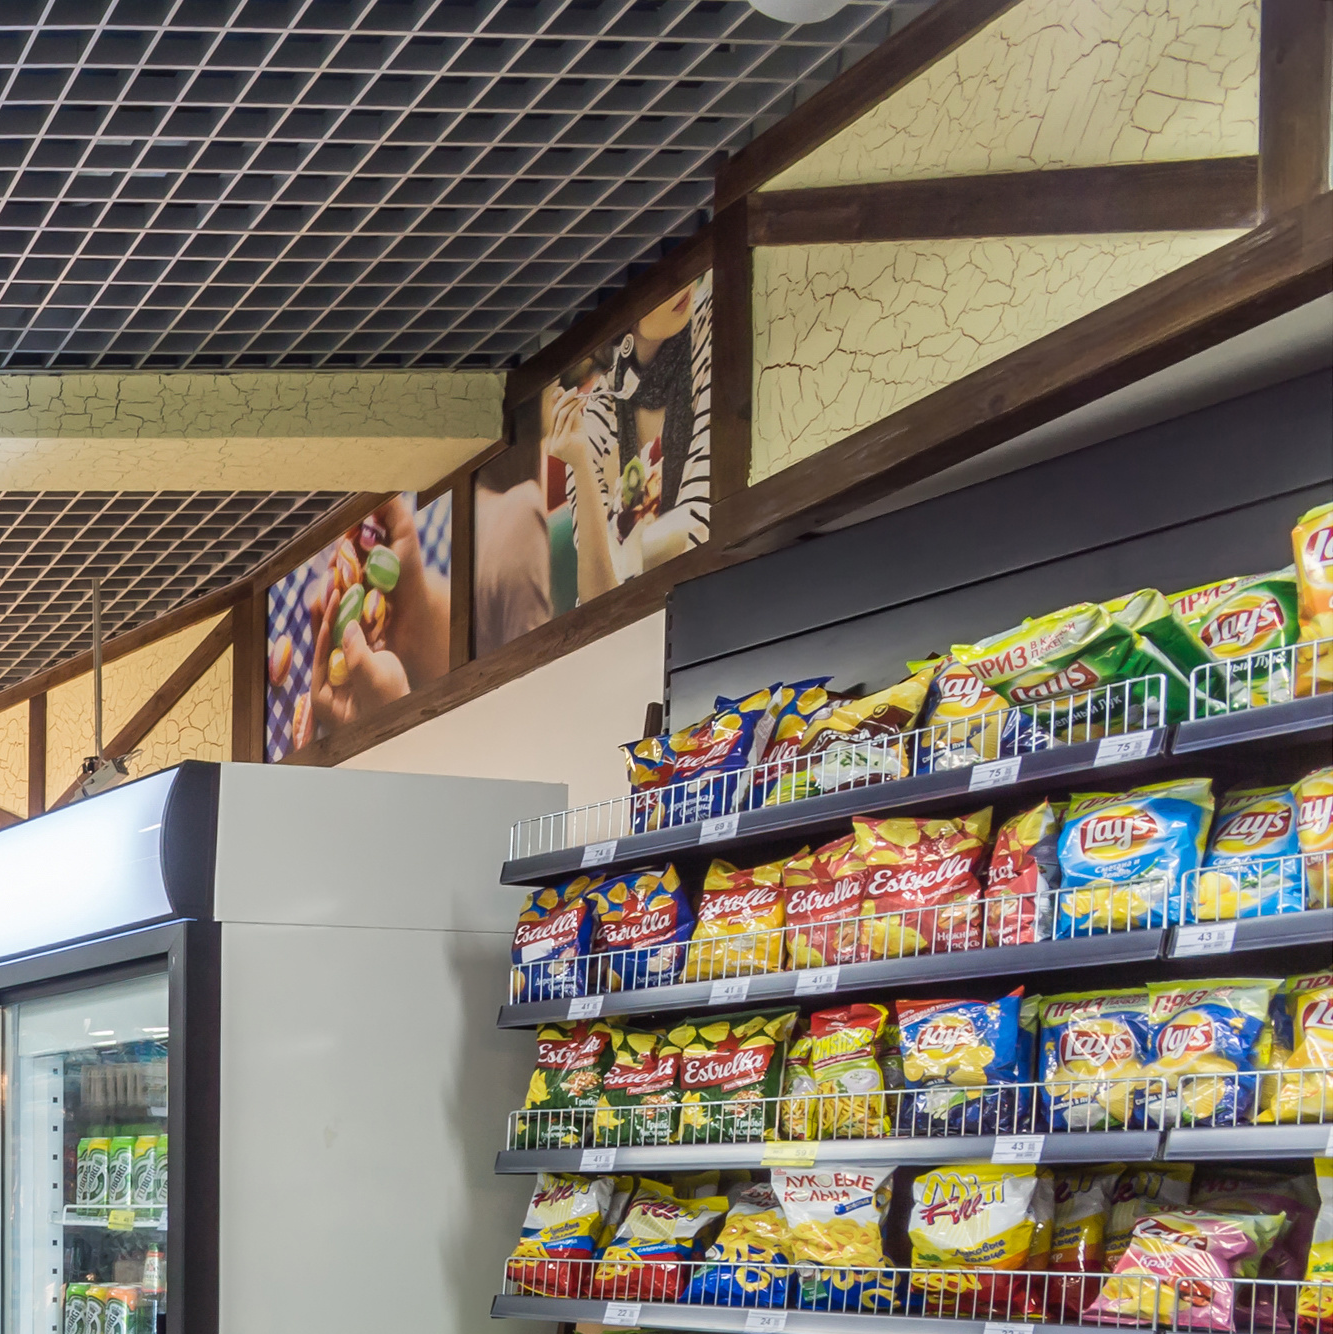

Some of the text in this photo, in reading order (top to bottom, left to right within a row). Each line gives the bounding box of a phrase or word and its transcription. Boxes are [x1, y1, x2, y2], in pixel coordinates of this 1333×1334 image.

[969, 646, 1028, 680] ПРИЗ
[1116, 742, 1131, 753] 75
[988, 768, 1001, 779] 75
[713, 822, 725, 832] 69
[1085, 812, 1158, 849] Lay's
[1221, 809, 1292, 845] Lay's
[868, 854, 971, 895] Estrella
[787, 878, 863, 914] Estrella
[1197, 932, 1213, 943] 43
[811, 975, 823, 985] 41
[1044, 996, 1103, 1019] ПРИЗ
[1152, 988, 1208, 1015] ПРИЗ
[1064, 1030, 1133, 1066] Lay's
[1162, 1022, 1213, 1060] Lay's
[684, 1049, 764, 1083] Estrella
[795, 1149, 807, 1157] 59
[1011, 1141, 1025, 1152] 43
[593, 1155, 603, 1164] 41
[921, 1172, 1005, 1206] Mini
[951, 1238, 1006, 1258] Луковые
[963, 1248, 1006, 1264] кольца
[1141, 1254, 1174, 1270] Краб
[616, 1308, 627, 1318] 22
[759, 1317, 772, 1327] 24
